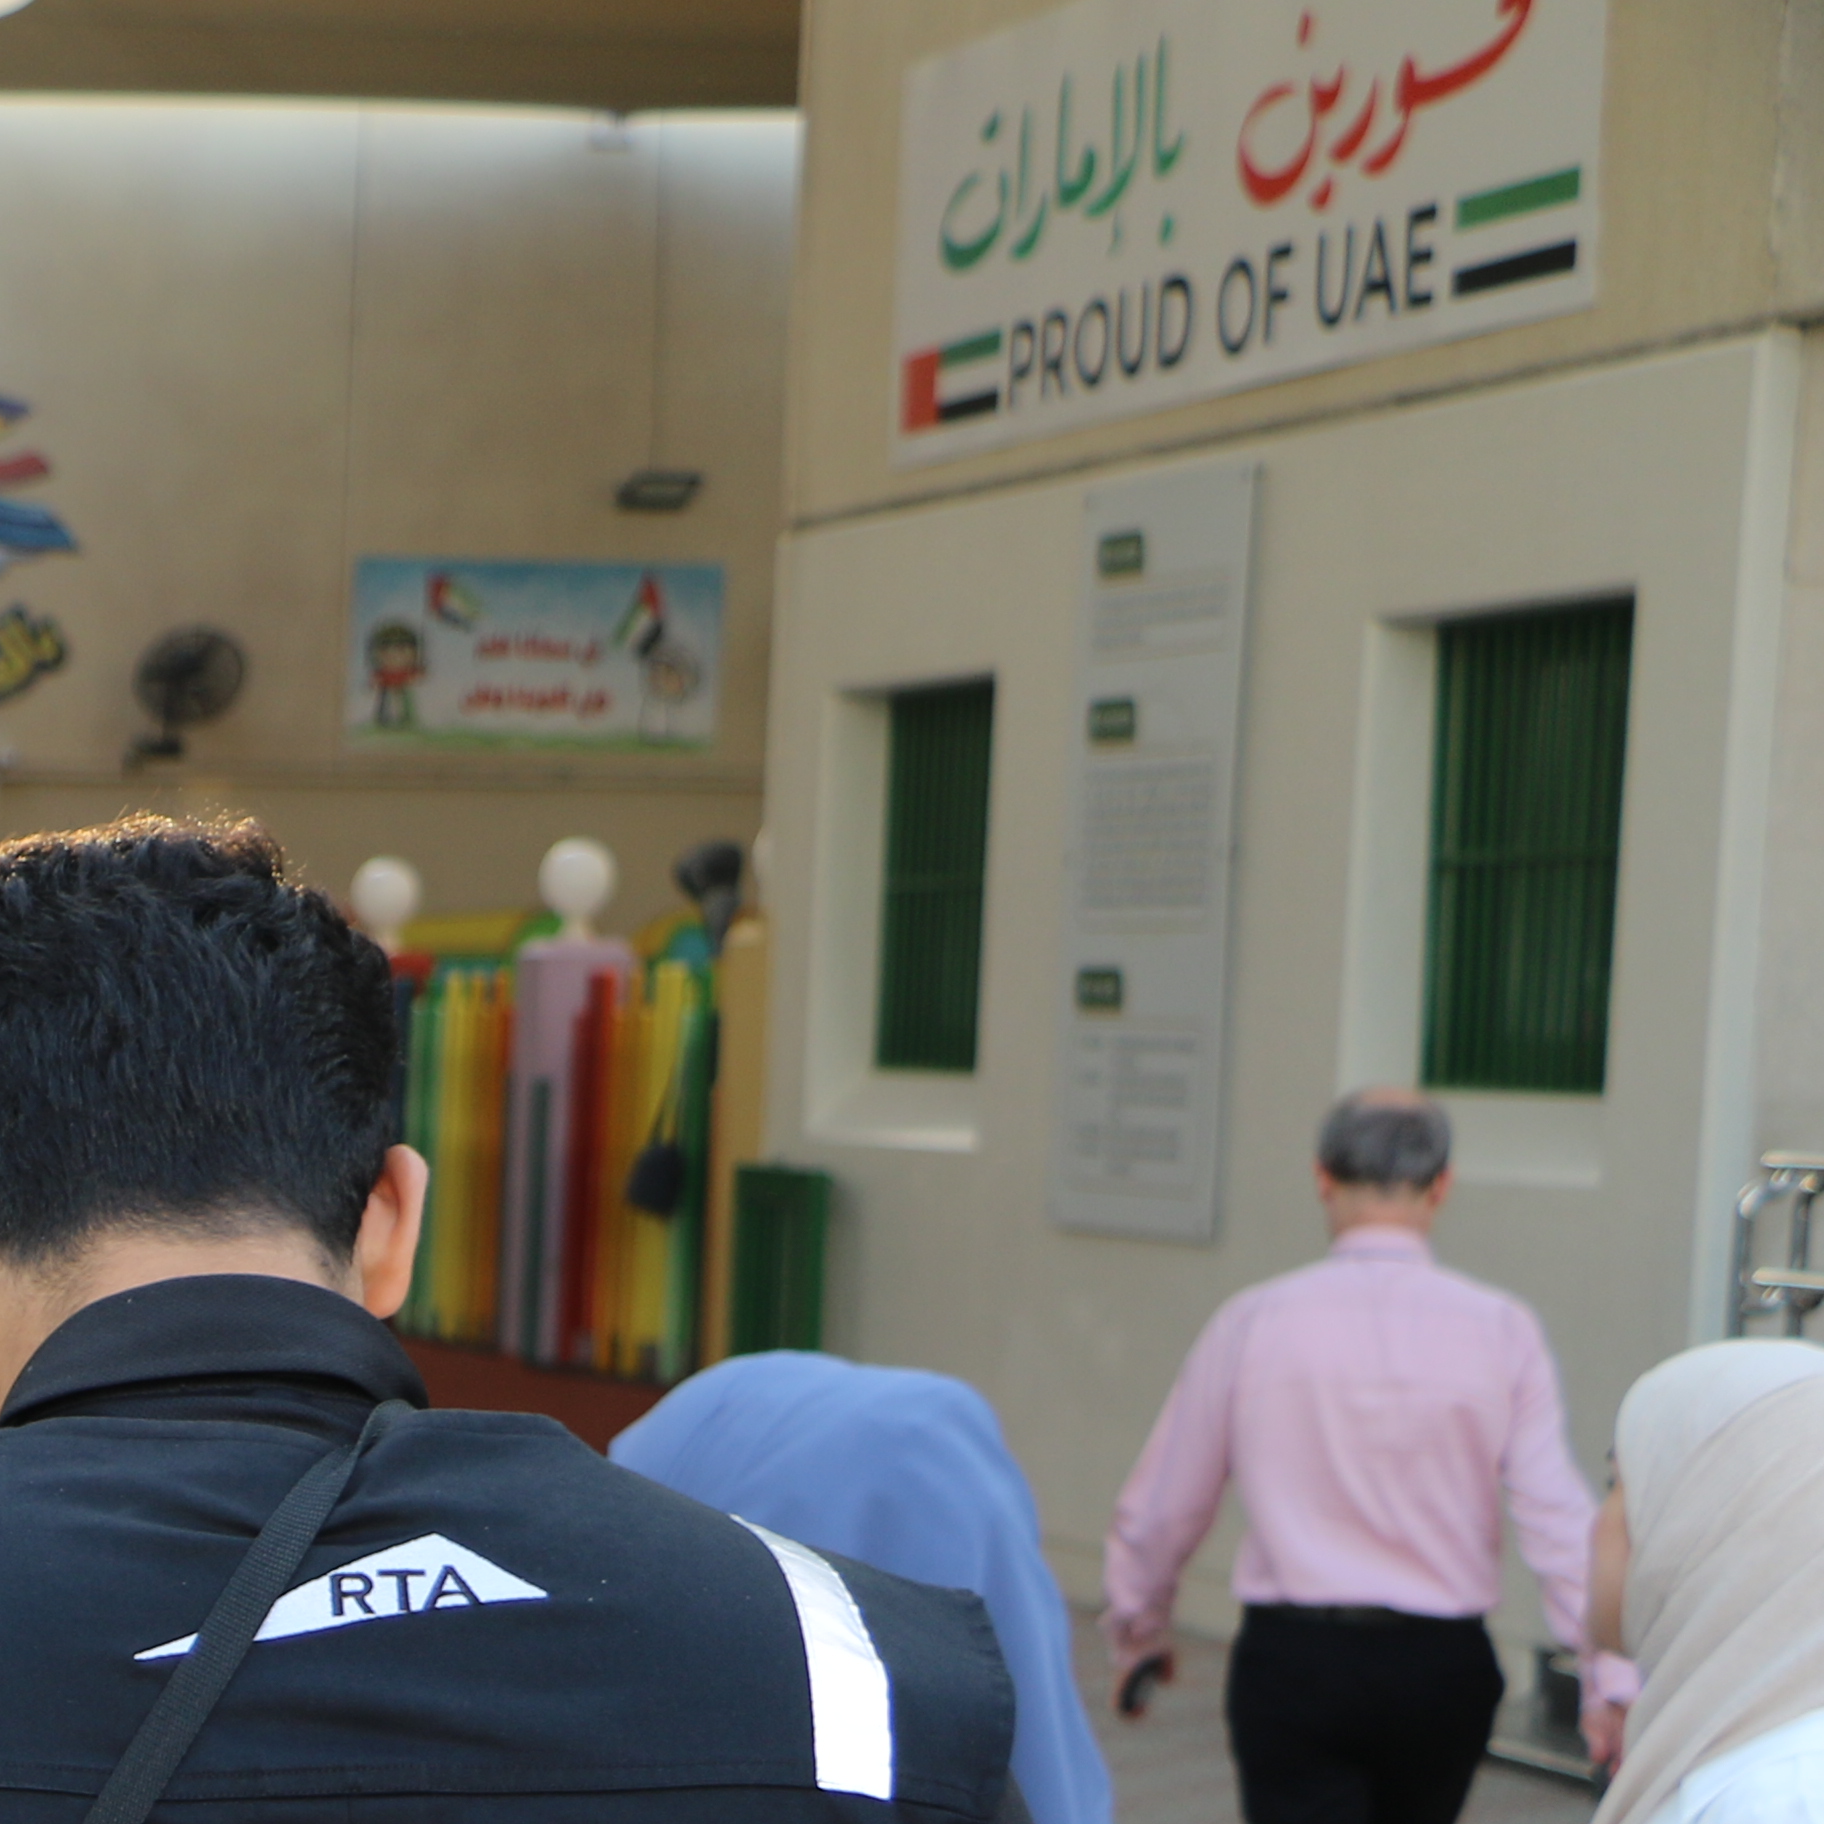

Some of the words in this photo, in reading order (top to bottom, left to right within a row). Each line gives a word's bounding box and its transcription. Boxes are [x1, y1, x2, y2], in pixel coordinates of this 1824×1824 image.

[1007, 274, 1193, 404] PROUD
[1219, 242, 1293, 356] OF
[1316, 203, 1438, 328] UAE
[329, 1564, 482, 1617] RTA
